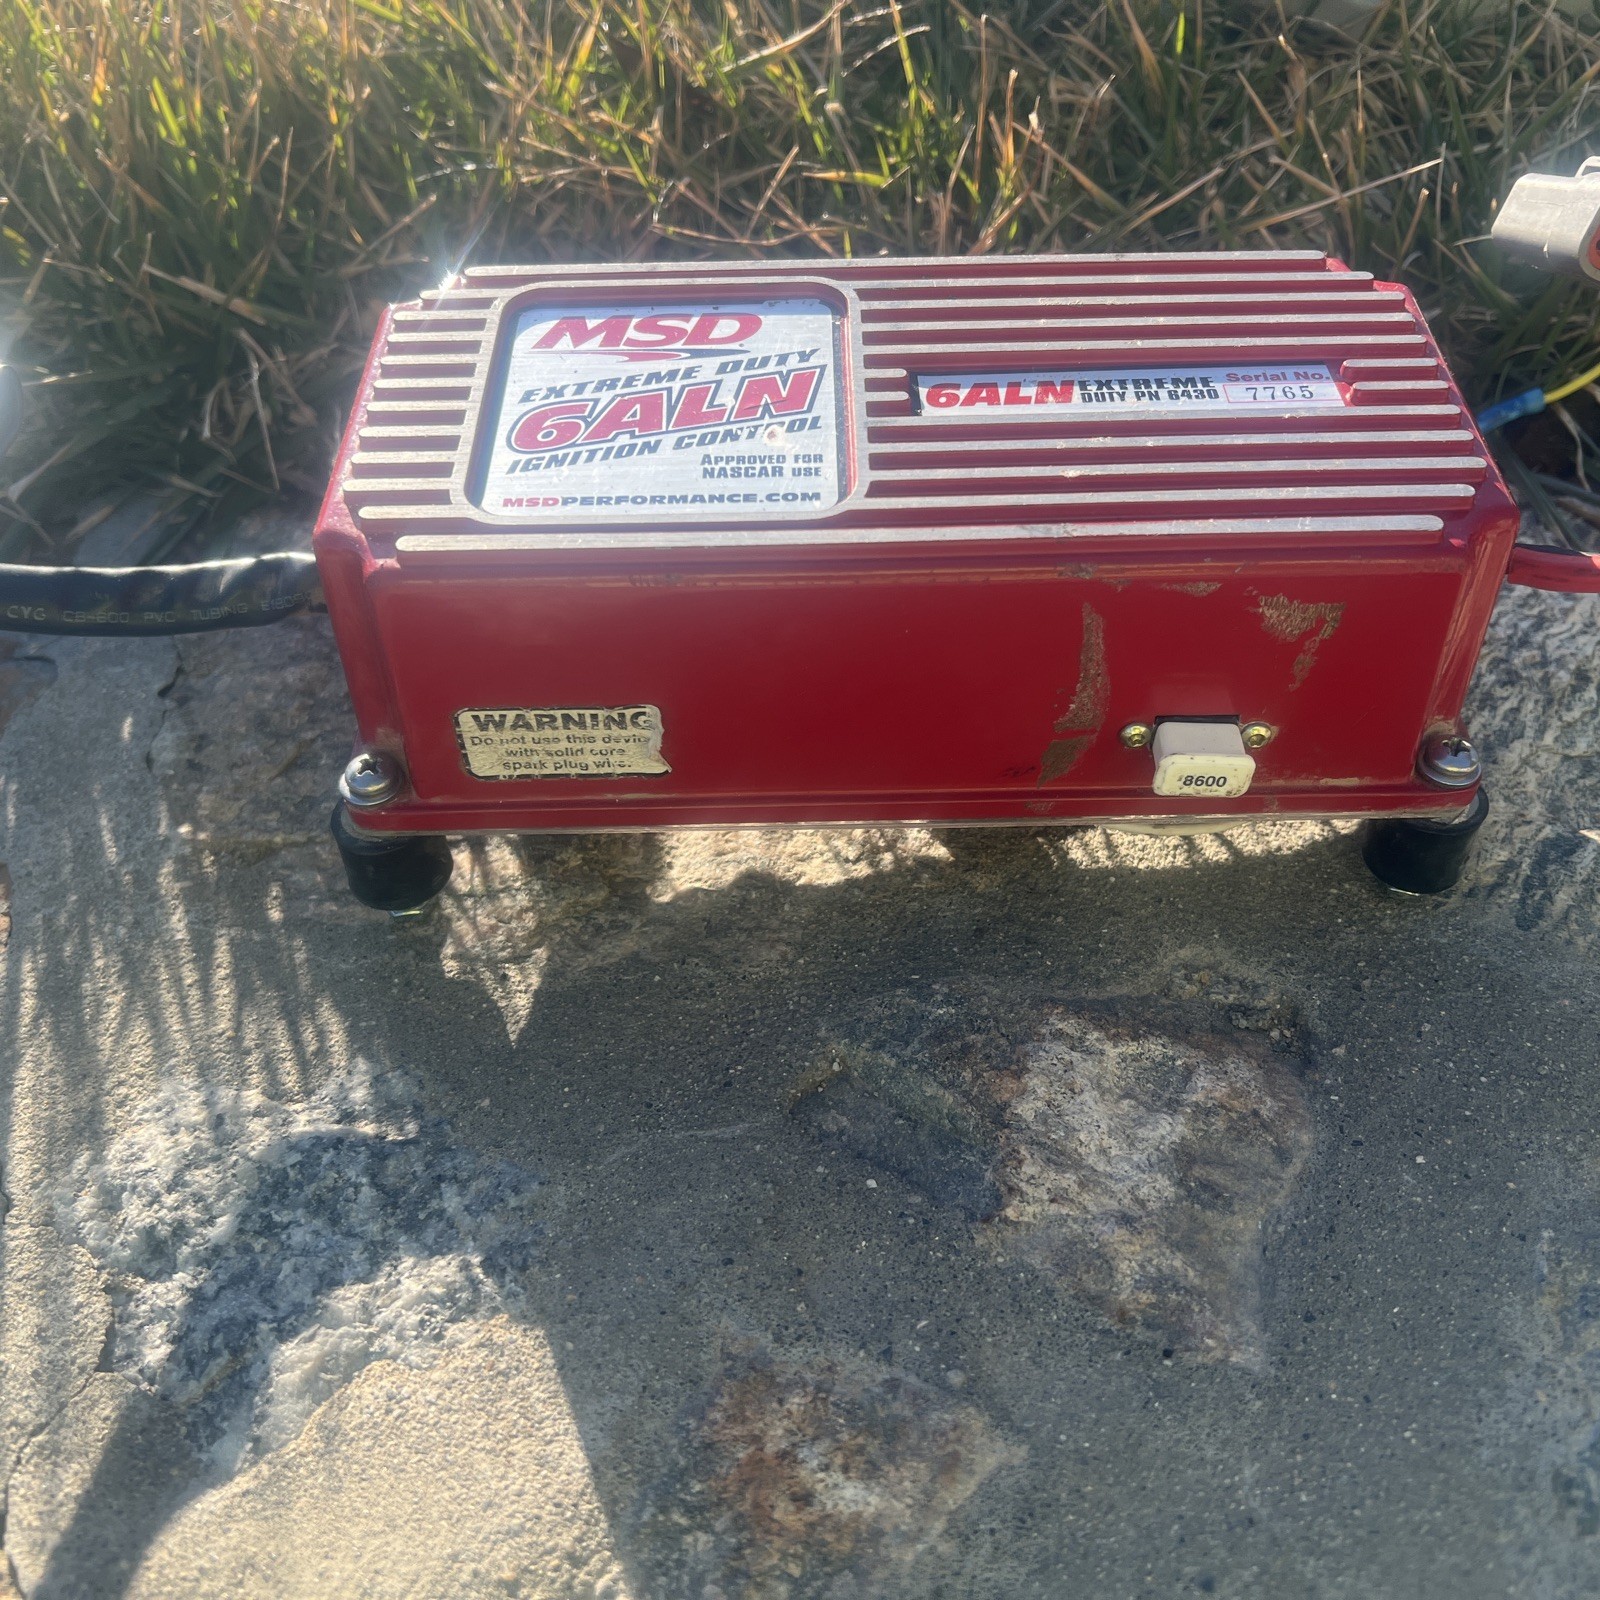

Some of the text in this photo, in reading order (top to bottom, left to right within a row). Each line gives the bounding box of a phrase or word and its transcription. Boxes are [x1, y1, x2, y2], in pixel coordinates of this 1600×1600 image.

[531, 313, 763, 349] MSD
[518, 348, 820, 404] EXTREME DUTY
[1078, 376, 1216, 391] EXTREME
[1226, 371, 1331, 382] Serial No.
[925, 380, 1075, 408] 6ALN
[1080, 388, 1219, 403] DUTY PN 6430
[1246, 385, 1314, 400] 7765
[506, 364, 827, 454] 6ALN
[506, 439, 663, 475] IGNITION
[701, 453, 823, 465] APPROVED FOR
[702, 466, 822, 479] NASCAR USE
[502, 492, 821, 508] MSDPERFORMANCE.COM
[6, 605, 47, 621] CYG
[143, 611, 176, 623] PVC
[190, 602, 248, 620] TUBING
[471, 712, 655, 732] WARNING
[470, 736, 494, 746] Do
[501, 734, 527, 745] not
[532, 736, 560, 745] use
[566, 733, 597, 744] this
[505, 746, 540, 758] with
[547, 747, 585, 757] solid
[503, 760, 548, 771] spark
[553, 758, 590, 771] plug
[1183, 775, 1227, 788] 8600
